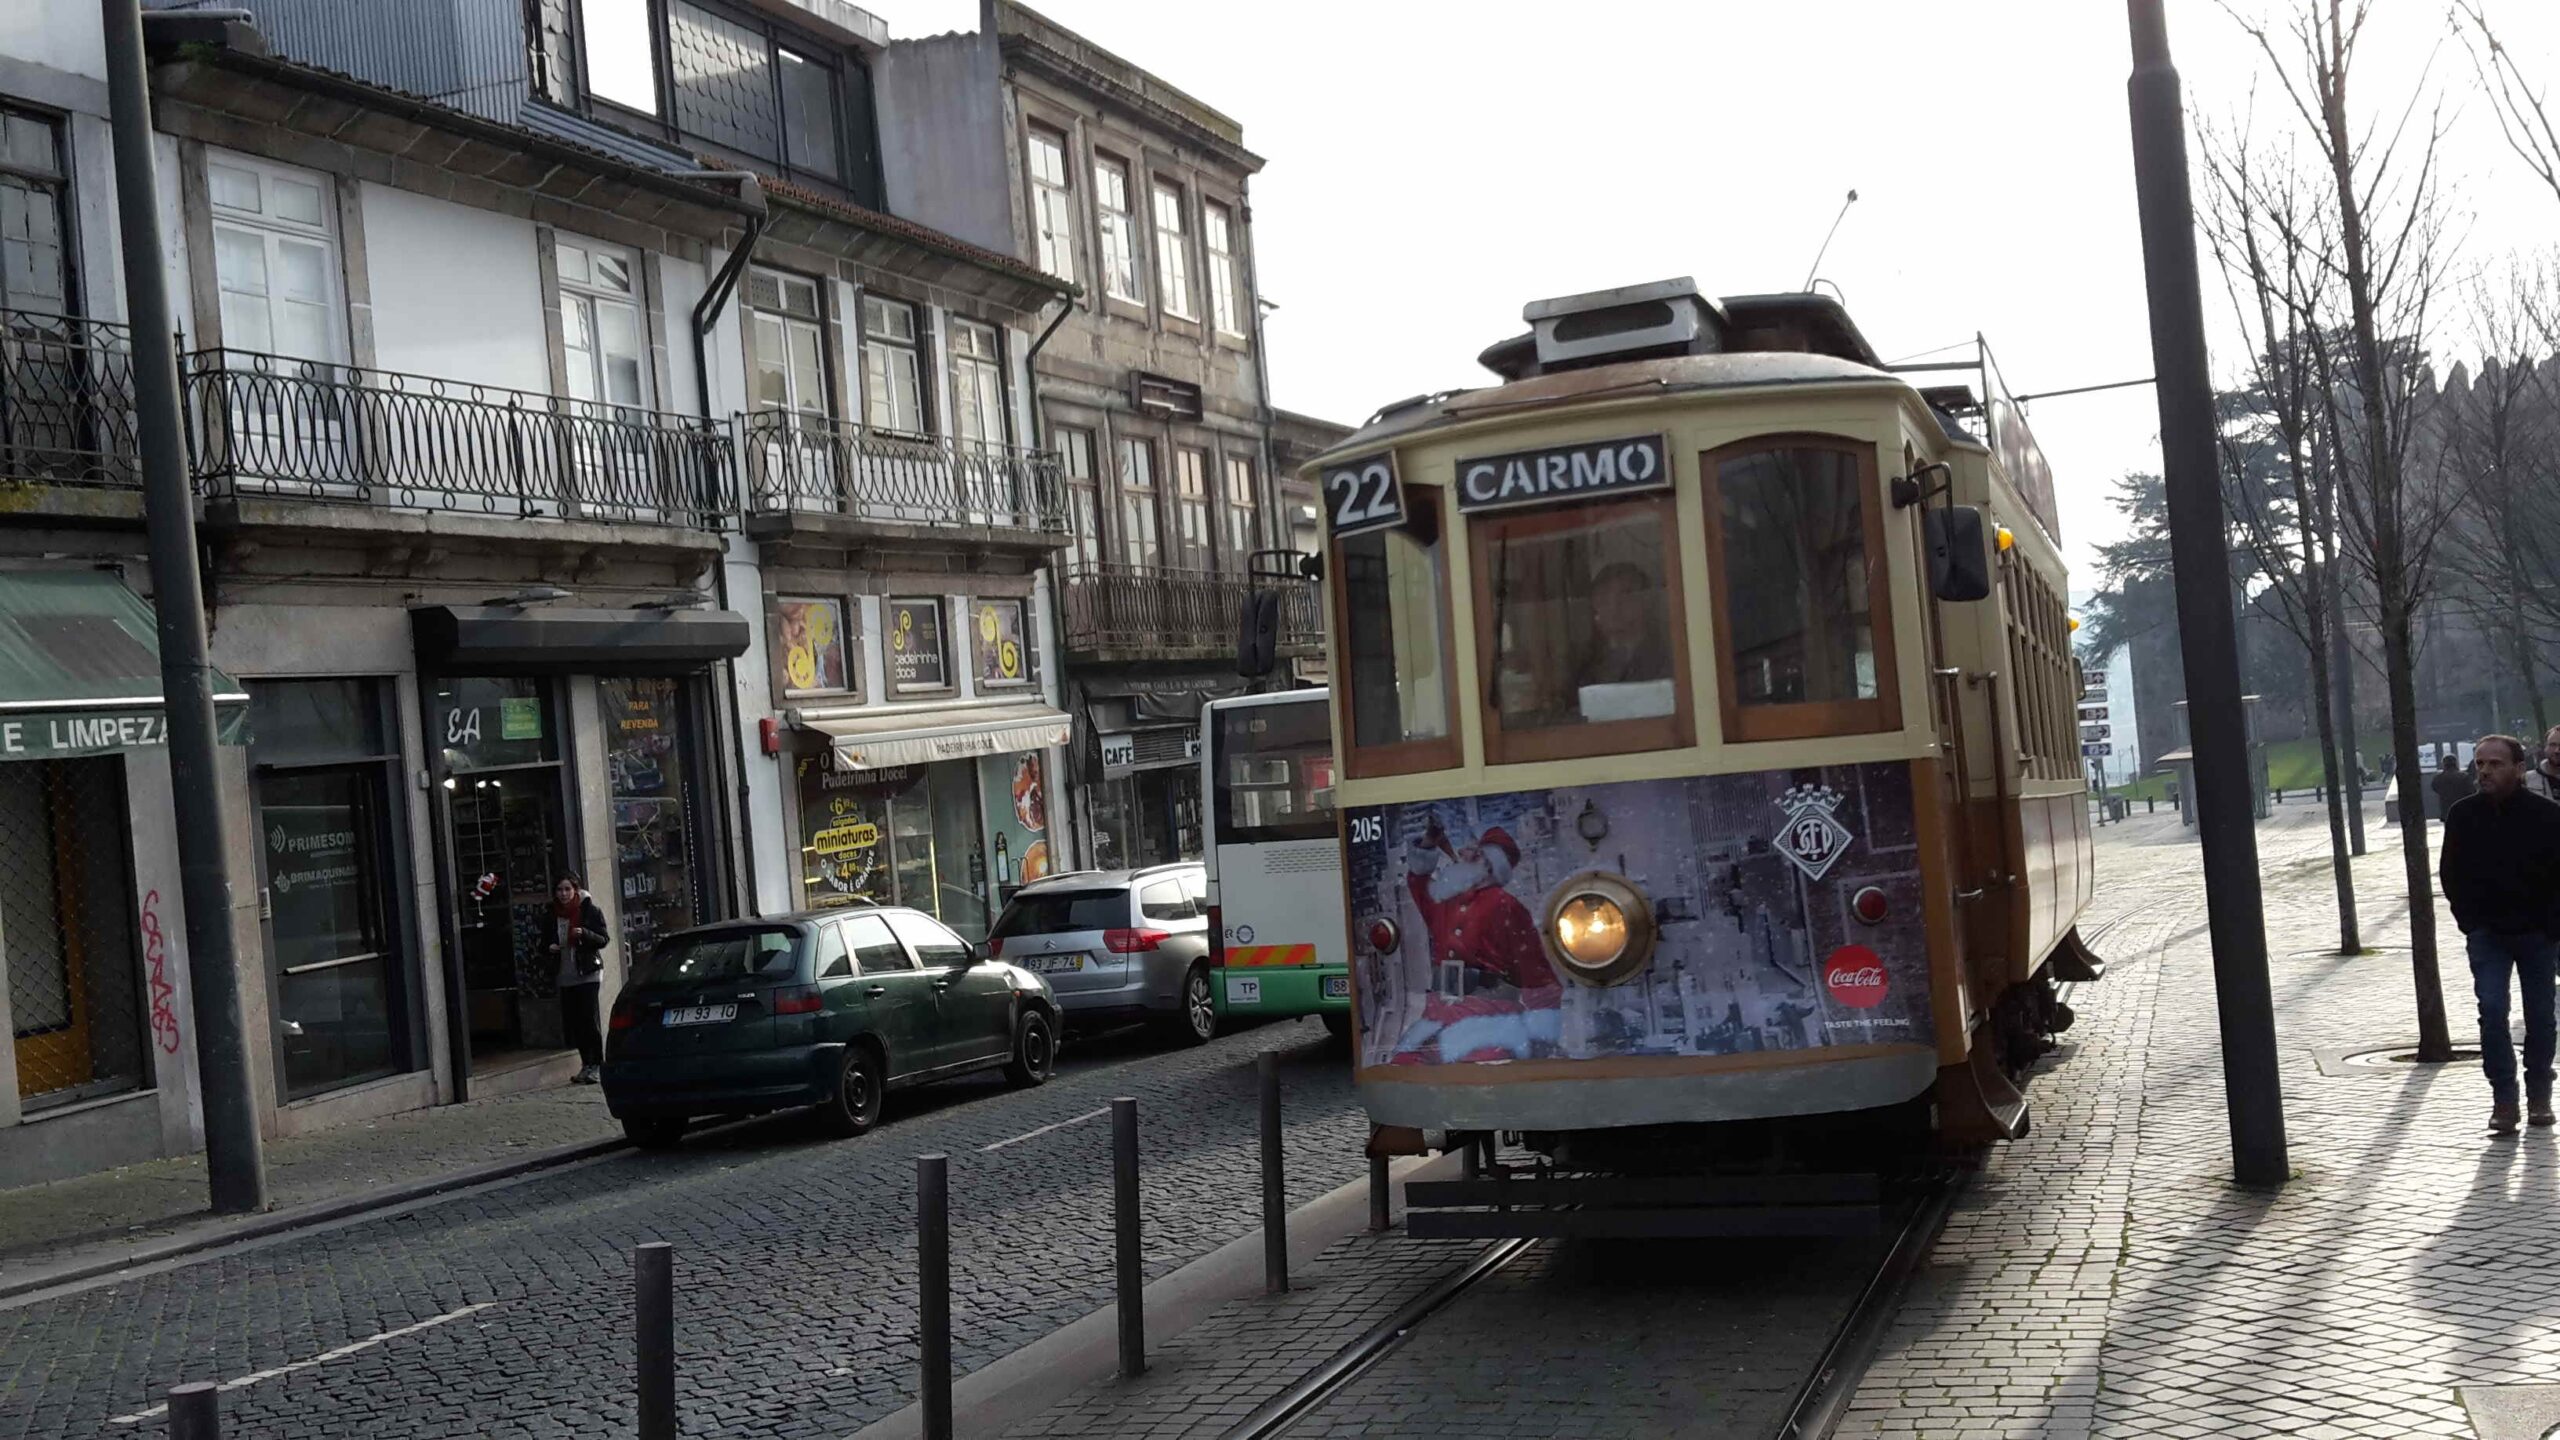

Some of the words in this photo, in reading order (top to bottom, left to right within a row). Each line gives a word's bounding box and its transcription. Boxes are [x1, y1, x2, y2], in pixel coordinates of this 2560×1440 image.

[1465, 444, 1655, 501] CARMO
[1331, 464, 1397, 526] 22
[620, 719, 659, 730] REVENDA
[4, 722, 25, 752] E
[822, 767, 878, 790] Padeirinha
[817, 828, 875, 851] miniaturas
[1351, 815, 1381, 843] 205
[1030, 959, 1042, 970] 93
[1240, 982, 1257, 994] TP
[1828, 966, 1883, 988] Coca-Cola
[672, 1008, 685, 1022] 71
[694, 1006, 711, 1020] 93
[1825, 1020, 1853, 1029] TASTE
[1853, 1019, 1873, 1027] THE
[1873, 1018, 1911, 1026] FEELING
